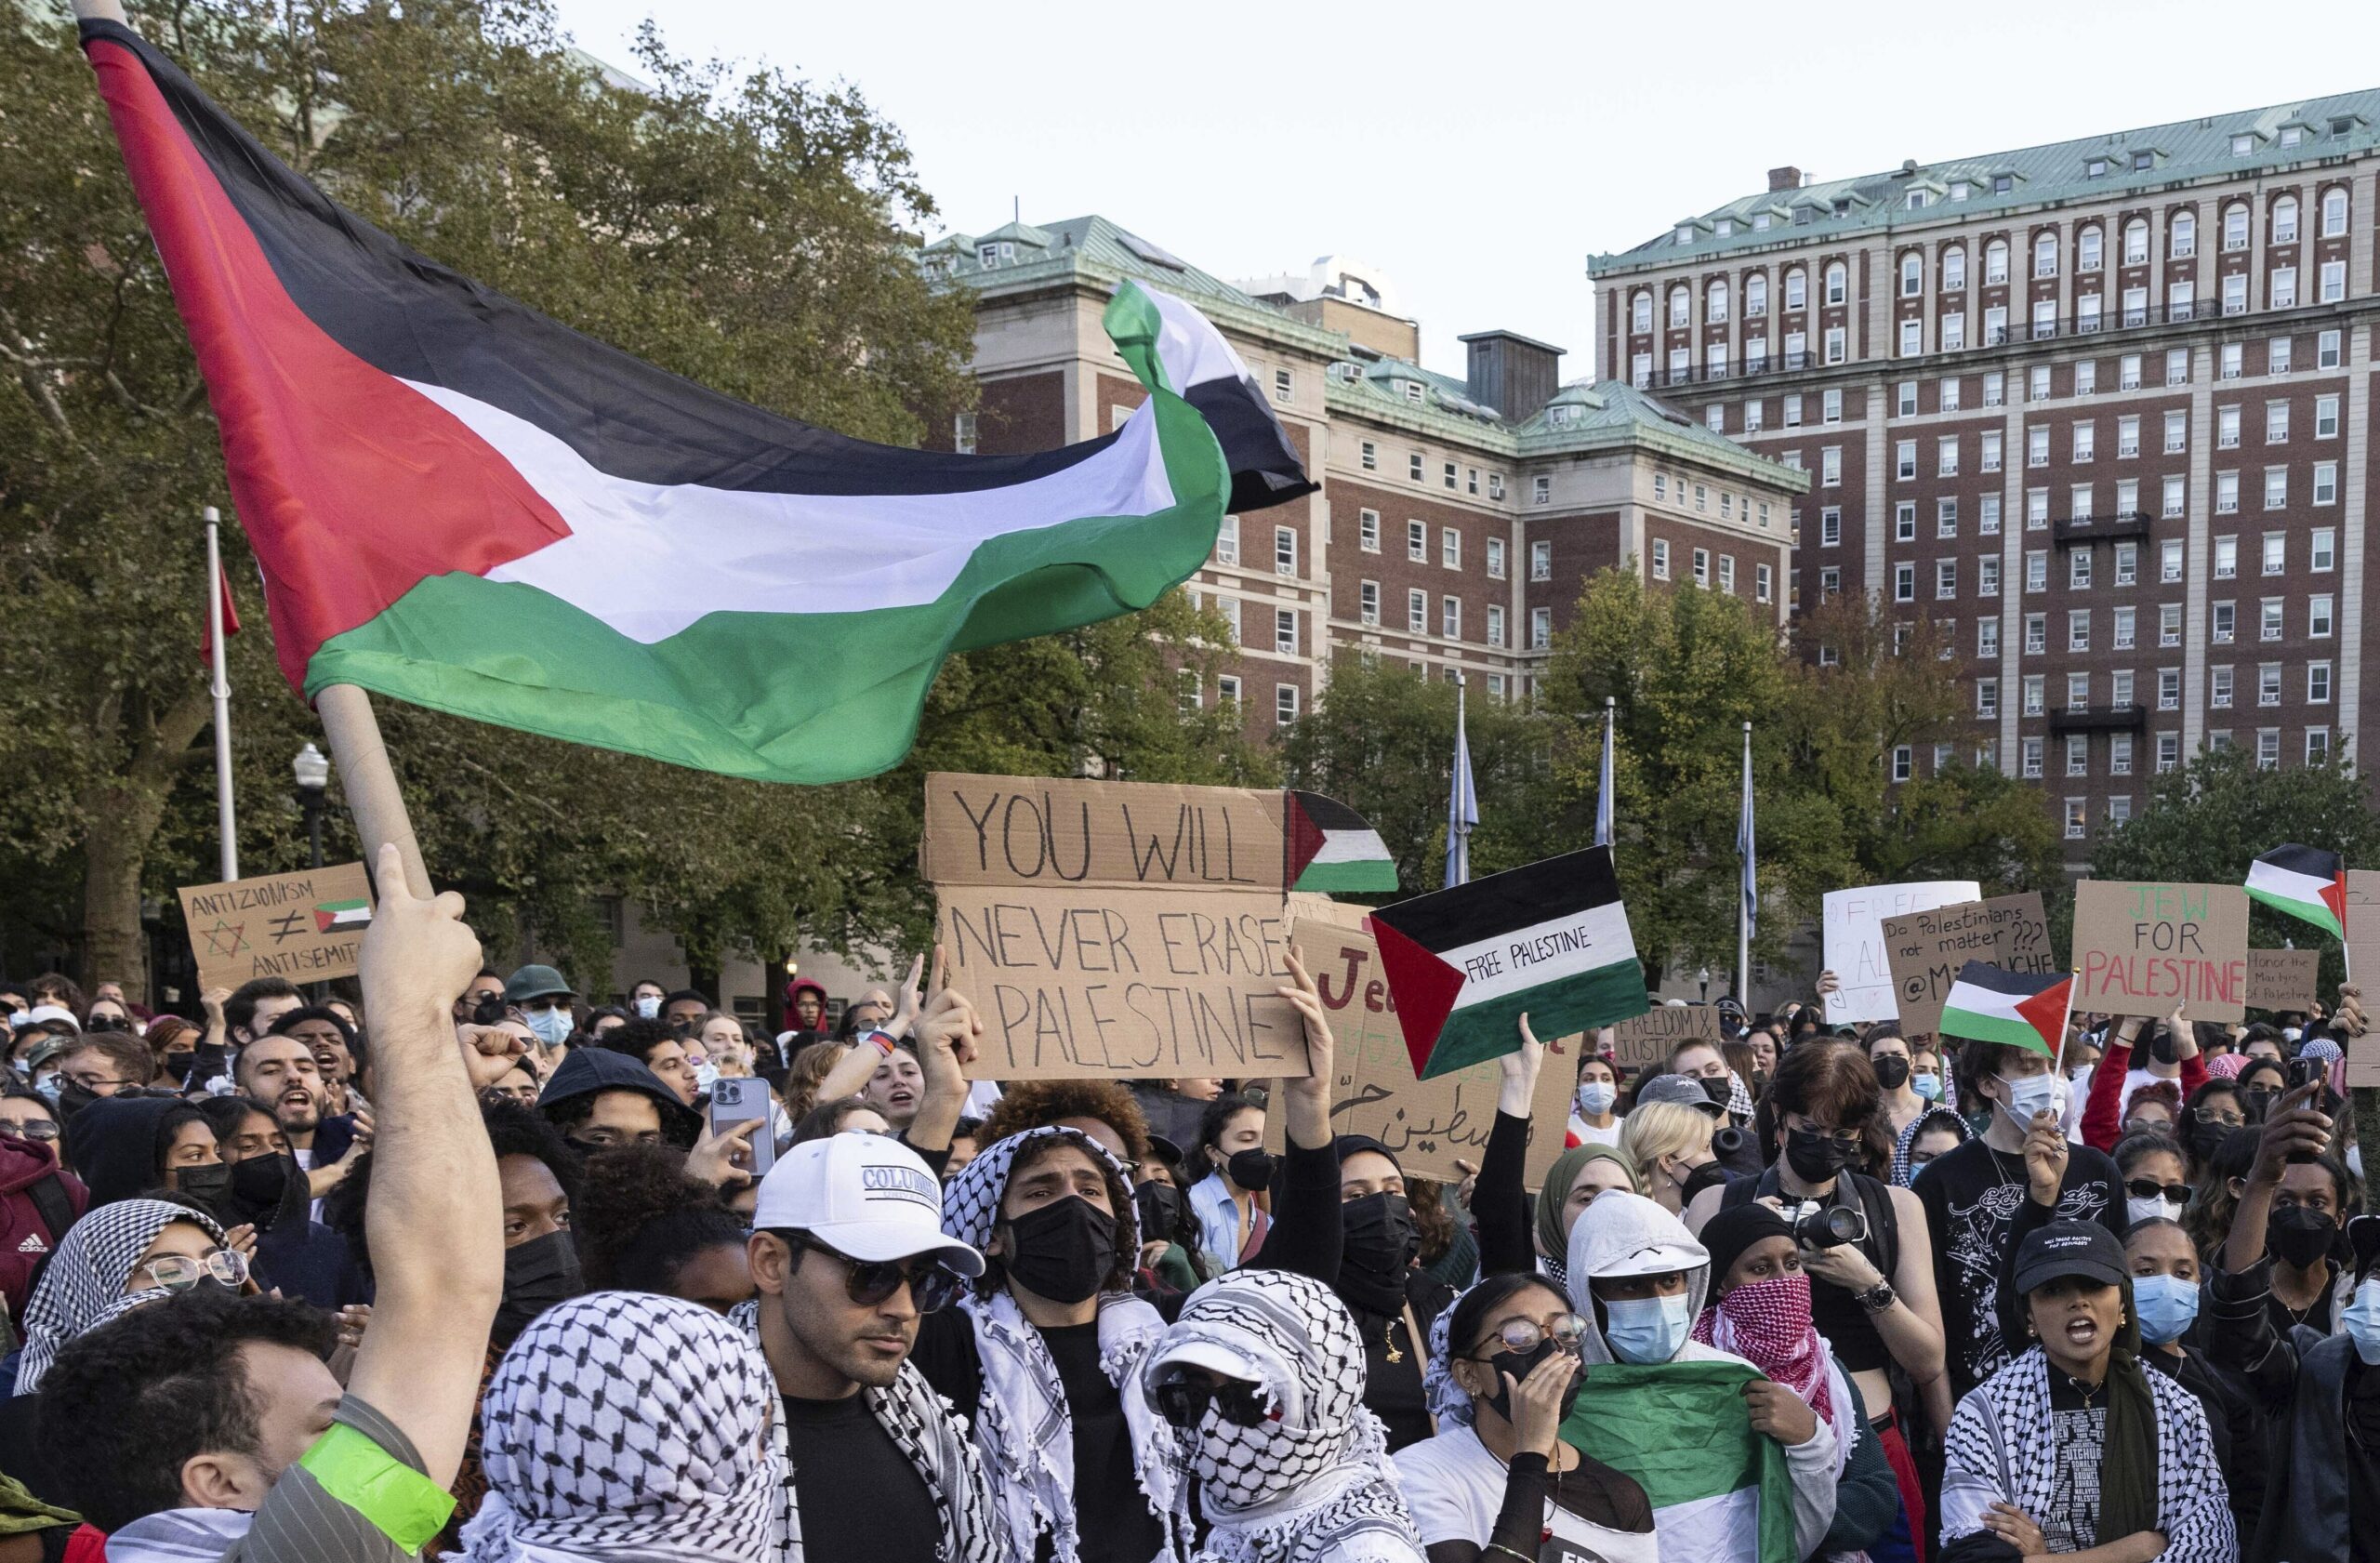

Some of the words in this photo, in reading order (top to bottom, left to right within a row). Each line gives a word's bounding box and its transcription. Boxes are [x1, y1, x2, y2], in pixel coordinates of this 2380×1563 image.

[953, 790, 1091, 882] YOU
[1121, 802, 1257, 883] WILL
[192, 880, 316, 919] ANTIZIONISM
[2127, 885, 2209, 921] JEW
[951, 903, 1141, 974] NEVER
[1158, 912, 1293, 977] ERASE
[1885, 922, 1907, 938] Do
[1917, 907, 2023, 937] Palestinians
[2135, 921, 2204, 954] FOR
[253, 943, 361, 977] ANTISEMIT
[1465, 949, 1503, 984] FREE
[1510, 926, 1593, 970] PALESTINE
[1836, 940, 1894, 982] PAL
[1900, 941, 1923, 957] not
[1938, 930, 2004, 953] matter
[1318, 947, 1395, 1013] Je
[2085, 950, 2247, 1004] PALESTINE
[2264, 987, 2310, 1000] Palestine
[994, 982, 1285, 1070] PALESTINE
[1699, 1009, 1712, 1038] &
[1620, 1038, 1676, 1062] JUSTIC
[1945, 1066, 1956, 1106] PALES
[2073, 1494, 2100, 1503] PALESTIN
